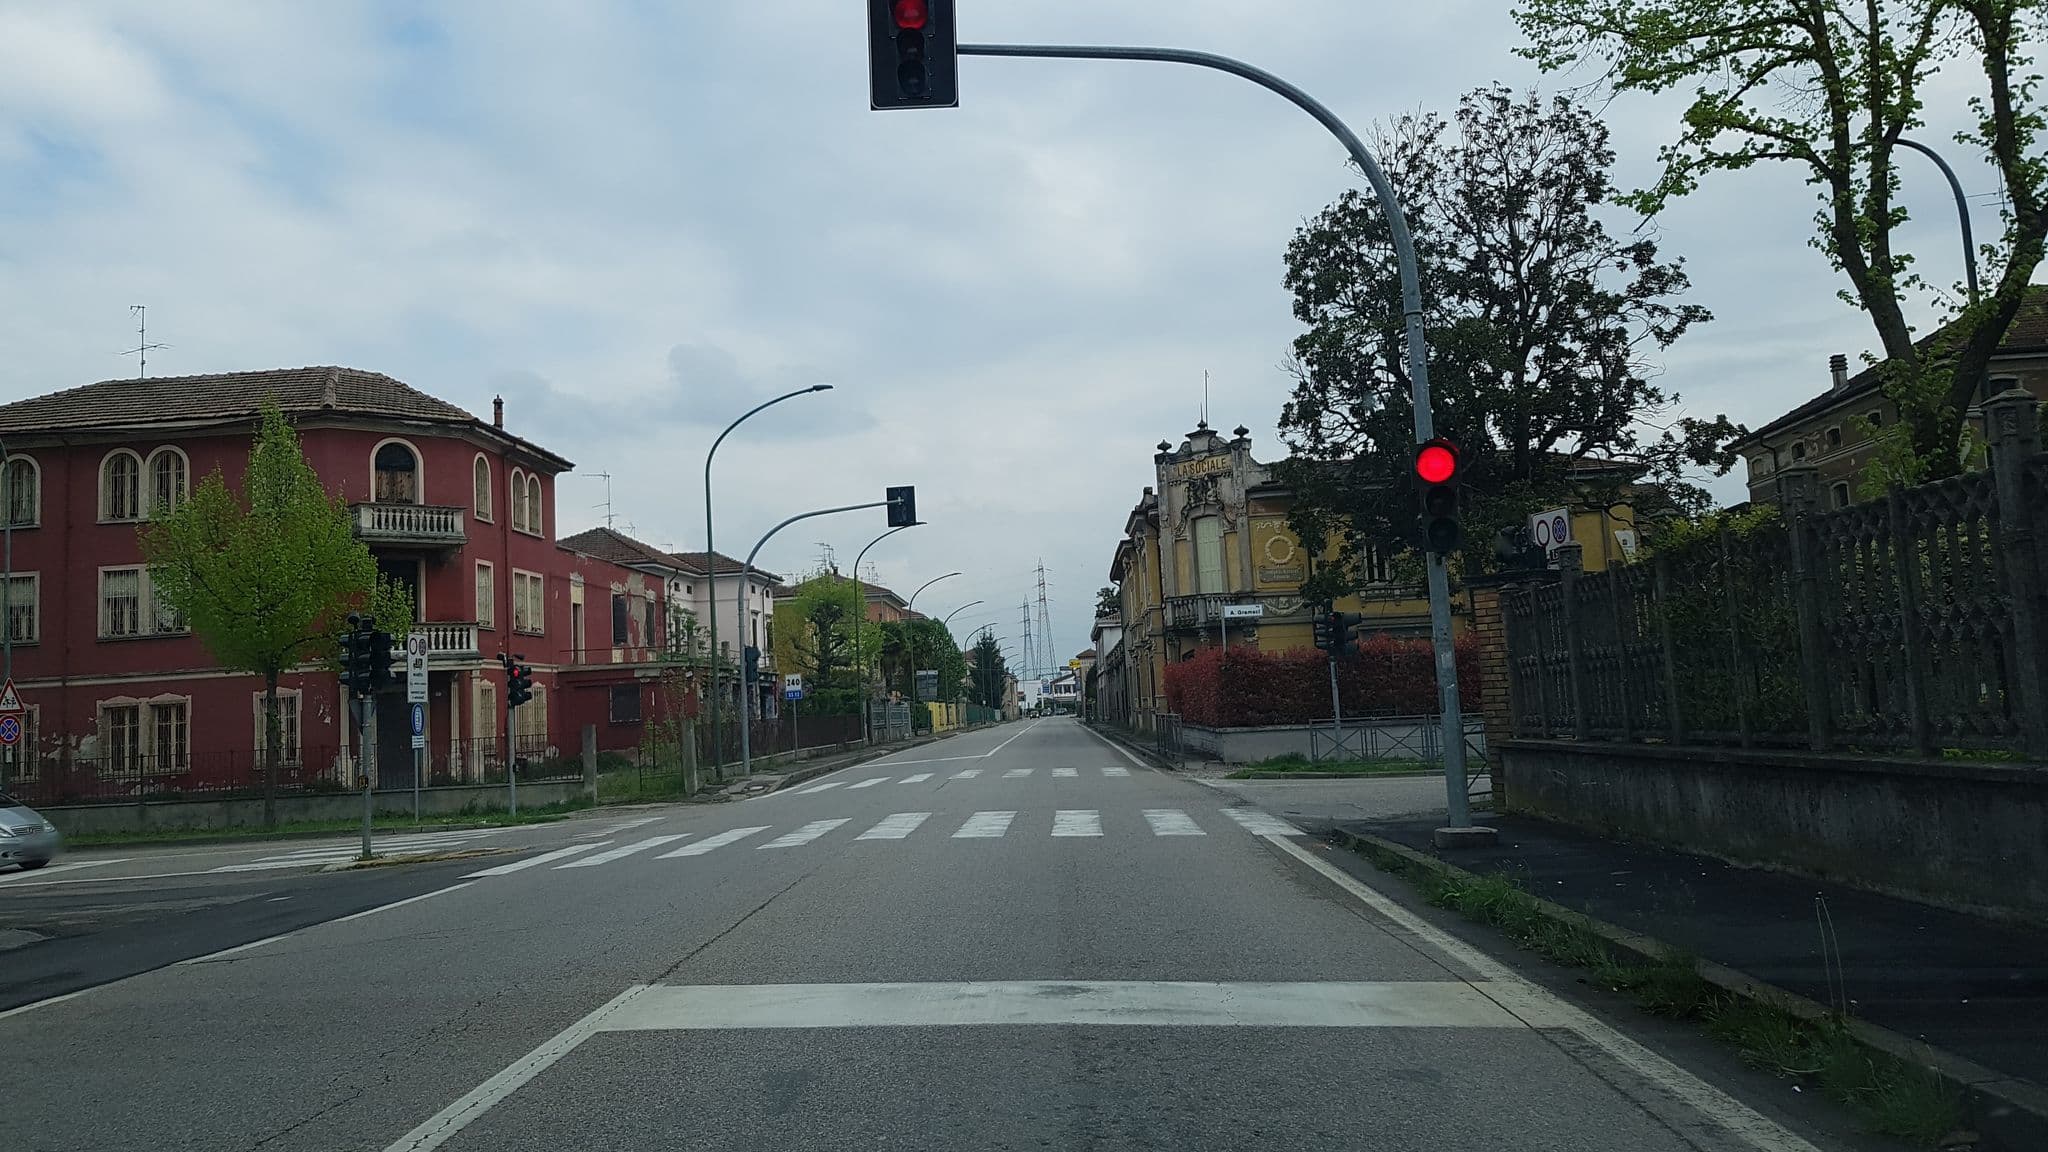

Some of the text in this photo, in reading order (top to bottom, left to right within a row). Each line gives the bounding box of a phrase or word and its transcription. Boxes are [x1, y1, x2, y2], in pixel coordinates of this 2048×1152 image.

[1178, 458, 1226, 476] LA SOCIALE
[786, 678, 800, 686] 240
